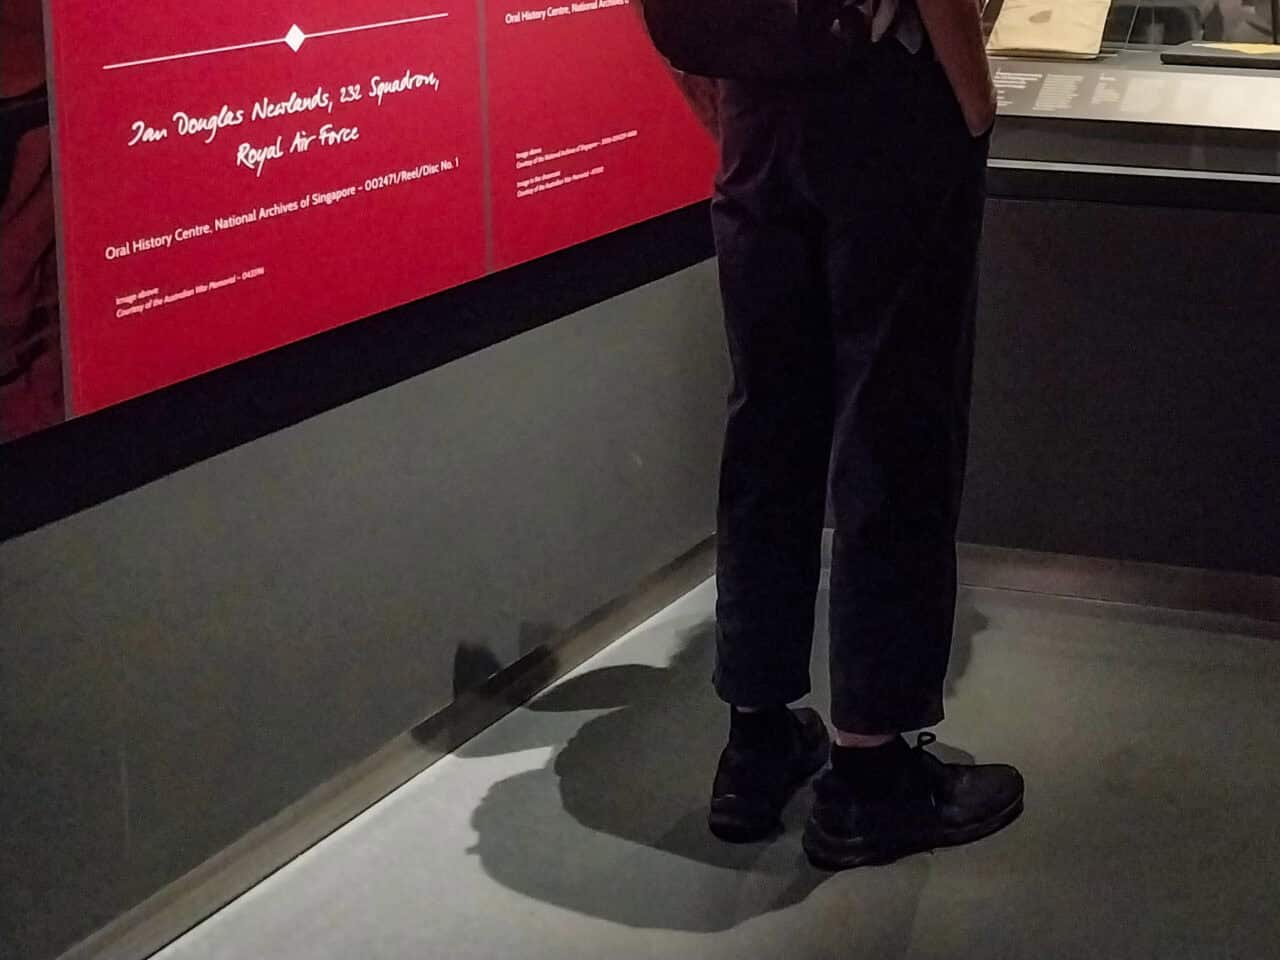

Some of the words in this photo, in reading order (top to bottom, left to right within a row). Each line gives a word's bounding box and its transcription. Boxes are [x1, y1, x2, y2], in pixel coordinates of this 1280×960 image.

[505, 11, 521, 24] Oral
[128, 121, 167, 146] Ian
[172, 105, 244, 143] Douglas
[252, 86, 333, 121] Newlands,
[340, 84, 362, 103] 232
[369, 69, 439, 105] Squadron,
[237, 136, 284, 177] Royal
[289, 131, 317, 153] Air
[318, 124, 359, 145] Force
[105, 242, 130, 259] Oral
[132, 234, 172, 253] History
[175, 224, 213, 241] Centre,
[215, 209, 257, 231] National
[259, 201, 299, 220] Archives
[300, 195, 310, 208] of
[312, 186, 356, 205] Singapore
